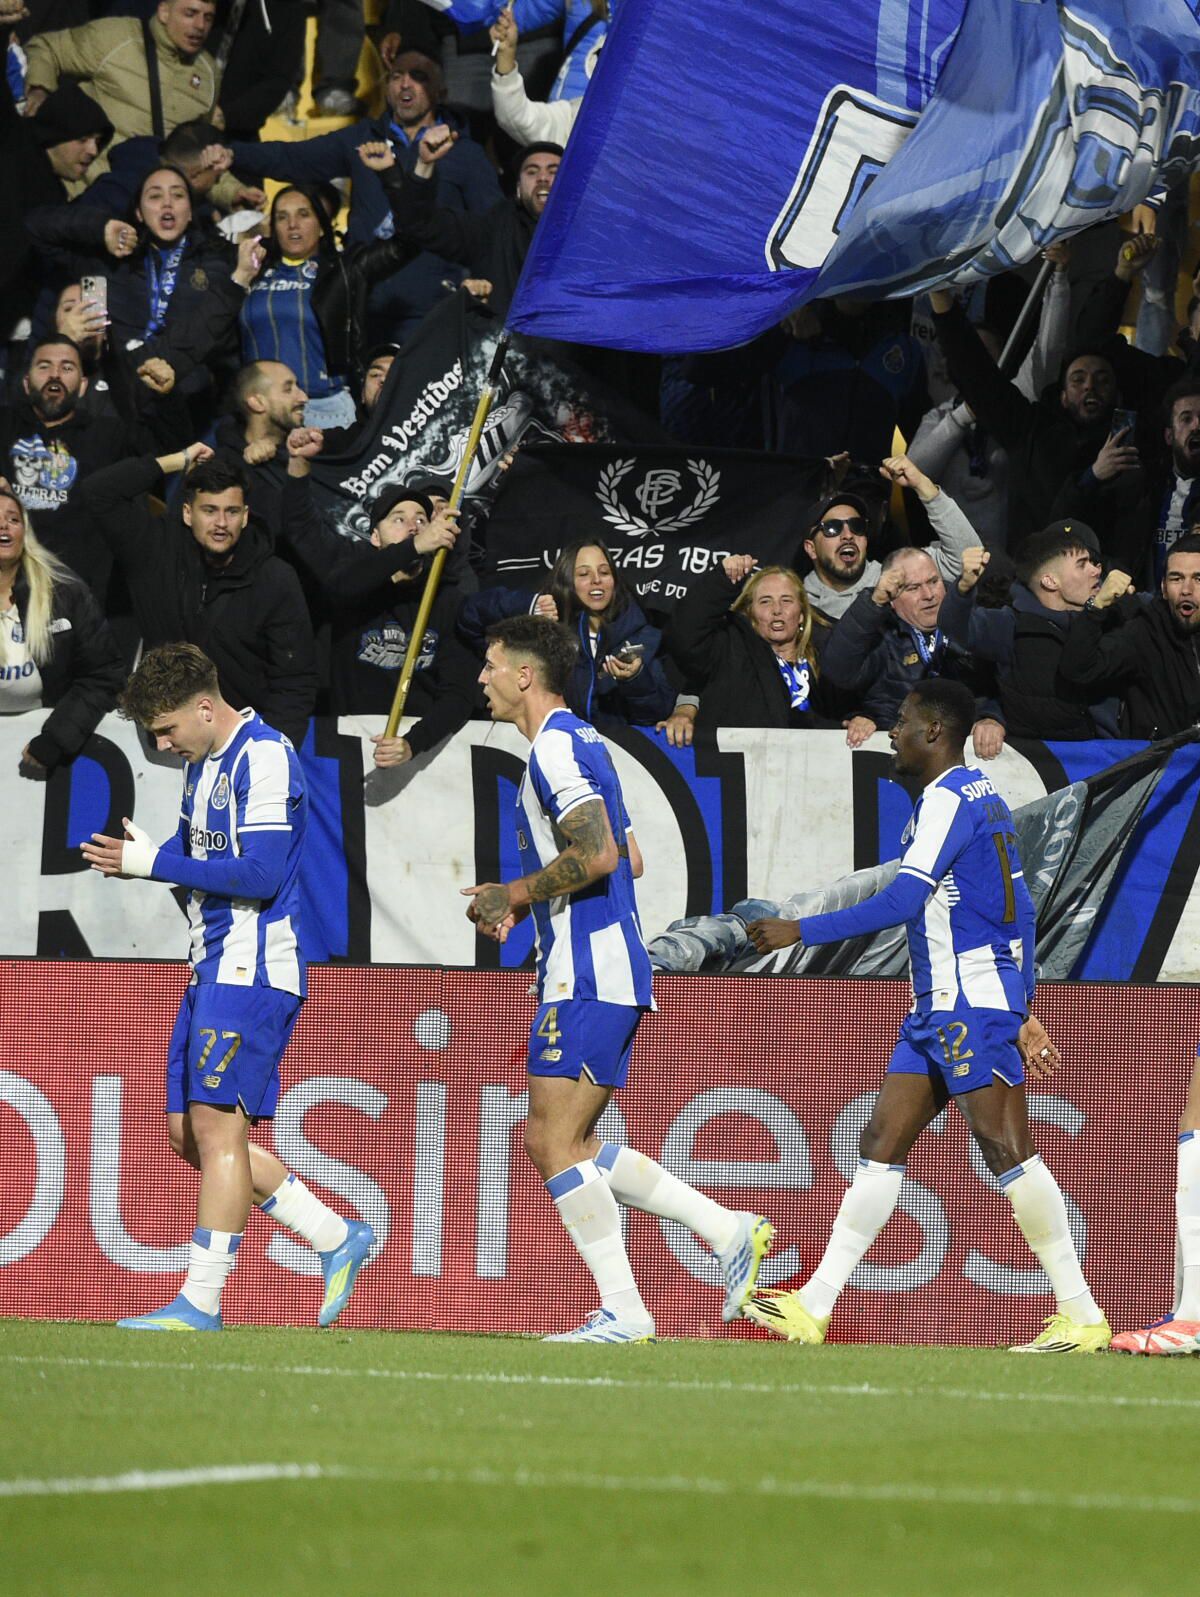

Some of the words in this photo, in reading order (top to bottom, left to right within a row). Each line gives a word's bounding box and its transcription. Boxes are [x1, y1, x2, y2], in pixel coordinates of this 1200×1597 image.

[339, 452, 393, 498] Bem
[381, 357, 465, 452] Vestidos
[960, 779, 997, 802] SUPE
[189, 823, 229, 851] etano
[536, 1006, 562, 1046] 4
[935, 1021, 975, 1065] 12
[196, 1028, 242, 1073] 77
